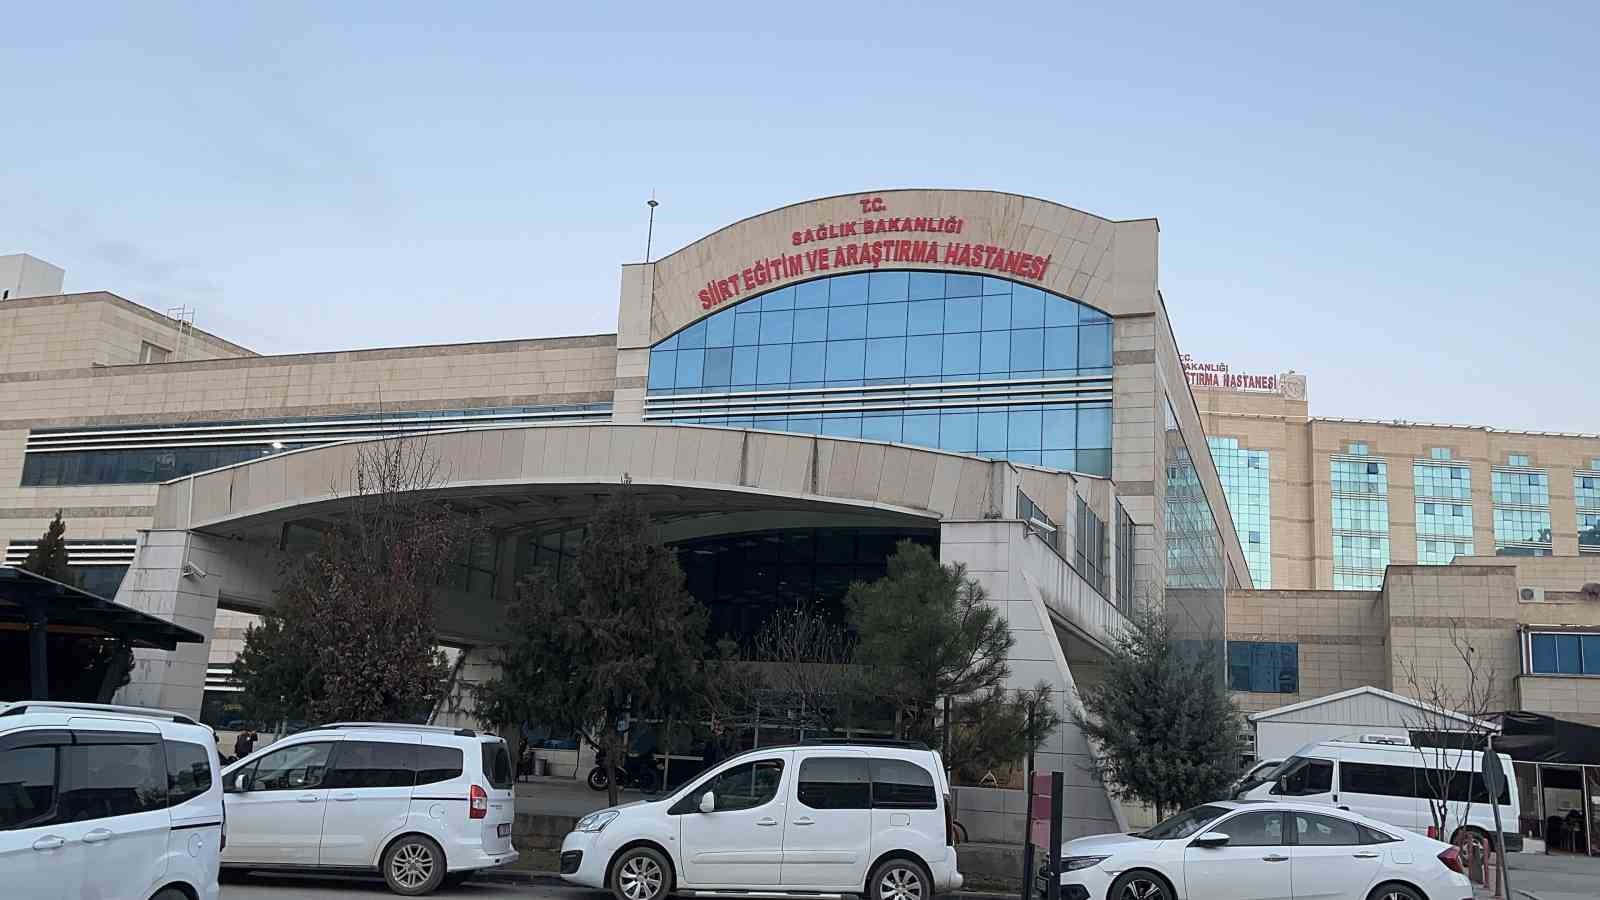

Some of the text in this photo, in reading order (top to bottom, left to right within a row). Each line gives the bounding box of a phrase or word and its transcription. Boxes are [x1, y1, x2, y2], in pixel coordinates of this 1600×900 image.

[859, 197, 886, 213] T.C.
[792, 216, 963, 246] SAĞLIK BAKANLIĞI
[697, 239, 1050, 310] SİİRT EĞİTİM VE ARAŞTIRMA HASTANESİ
[1223, 374, 1276, 389] HASTANESİ
